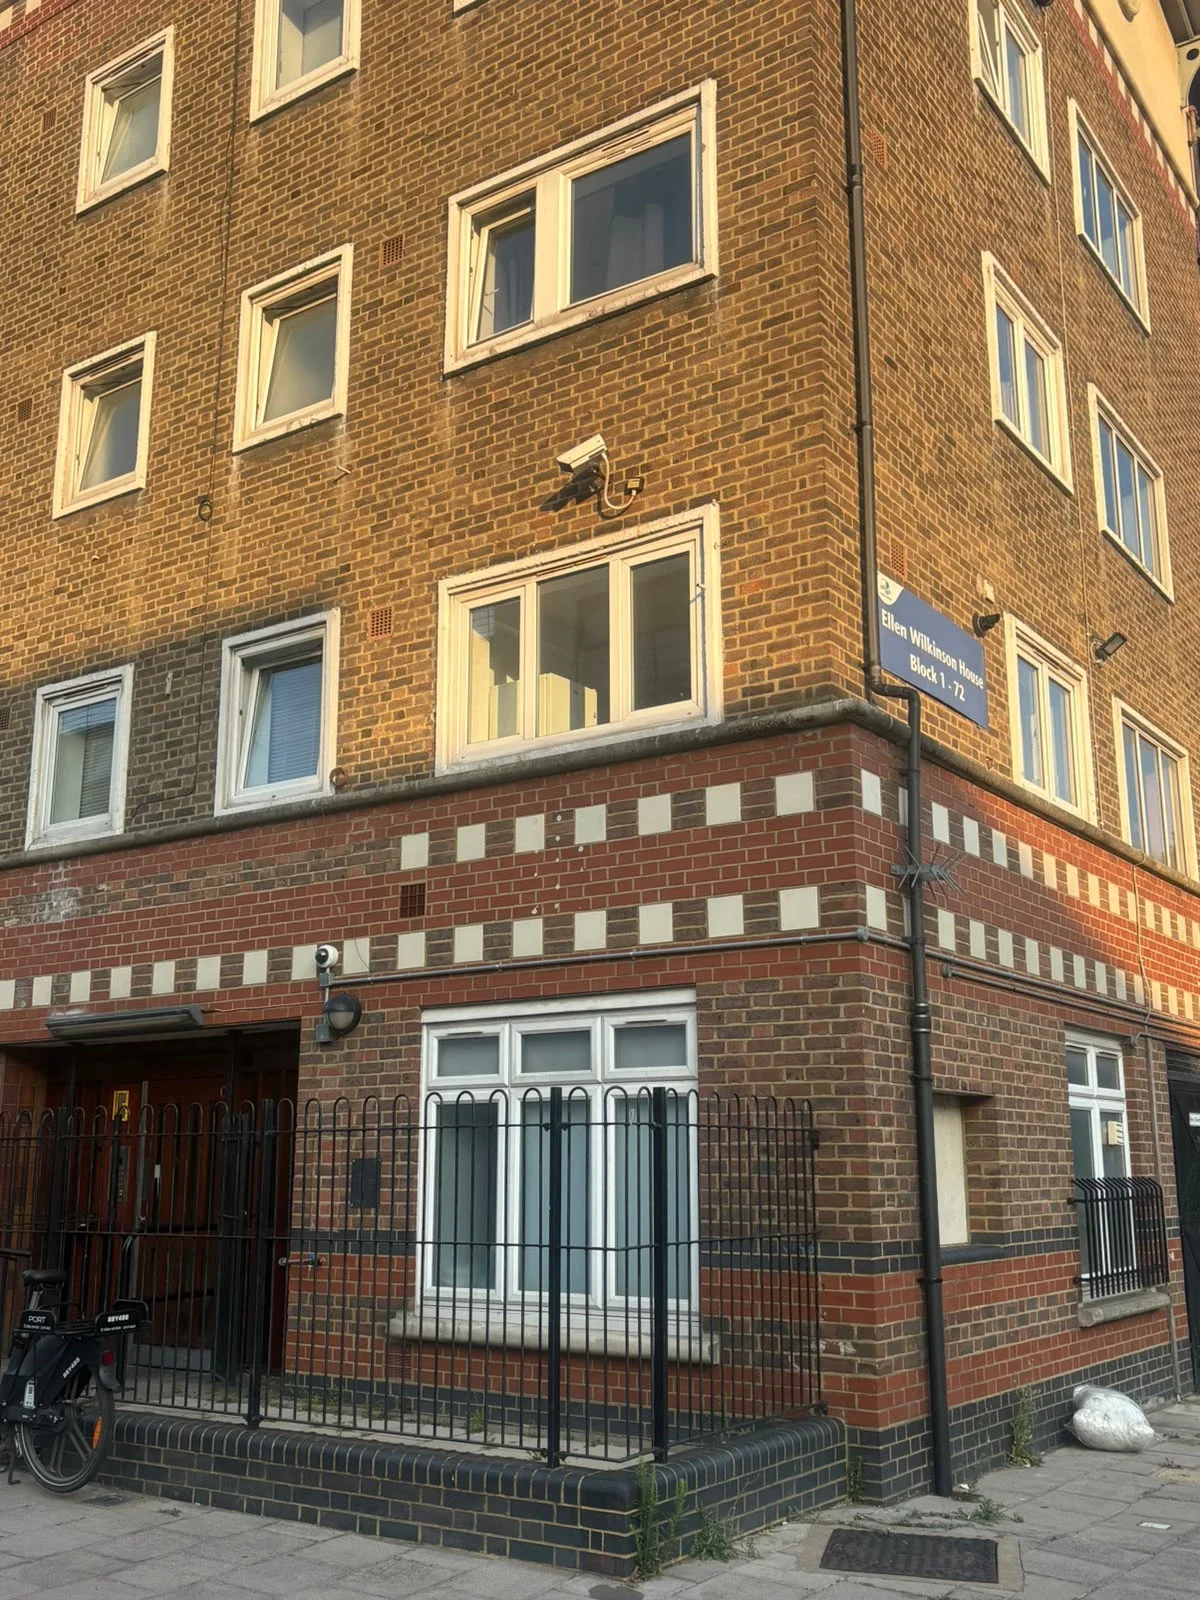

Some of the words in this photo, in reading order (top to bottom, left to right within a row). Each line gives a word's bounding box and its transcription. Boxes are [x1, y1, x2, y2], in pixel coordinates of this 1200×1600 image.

[881, 608, 908, 641] Ellen
[909, 626, 957, 671] Wilkinson
[959, 658, 984, 689] House
[909, 654, 938, 684] Block
[940, 672, 945, 689] 1
[953, 680, 966, 702] 72
